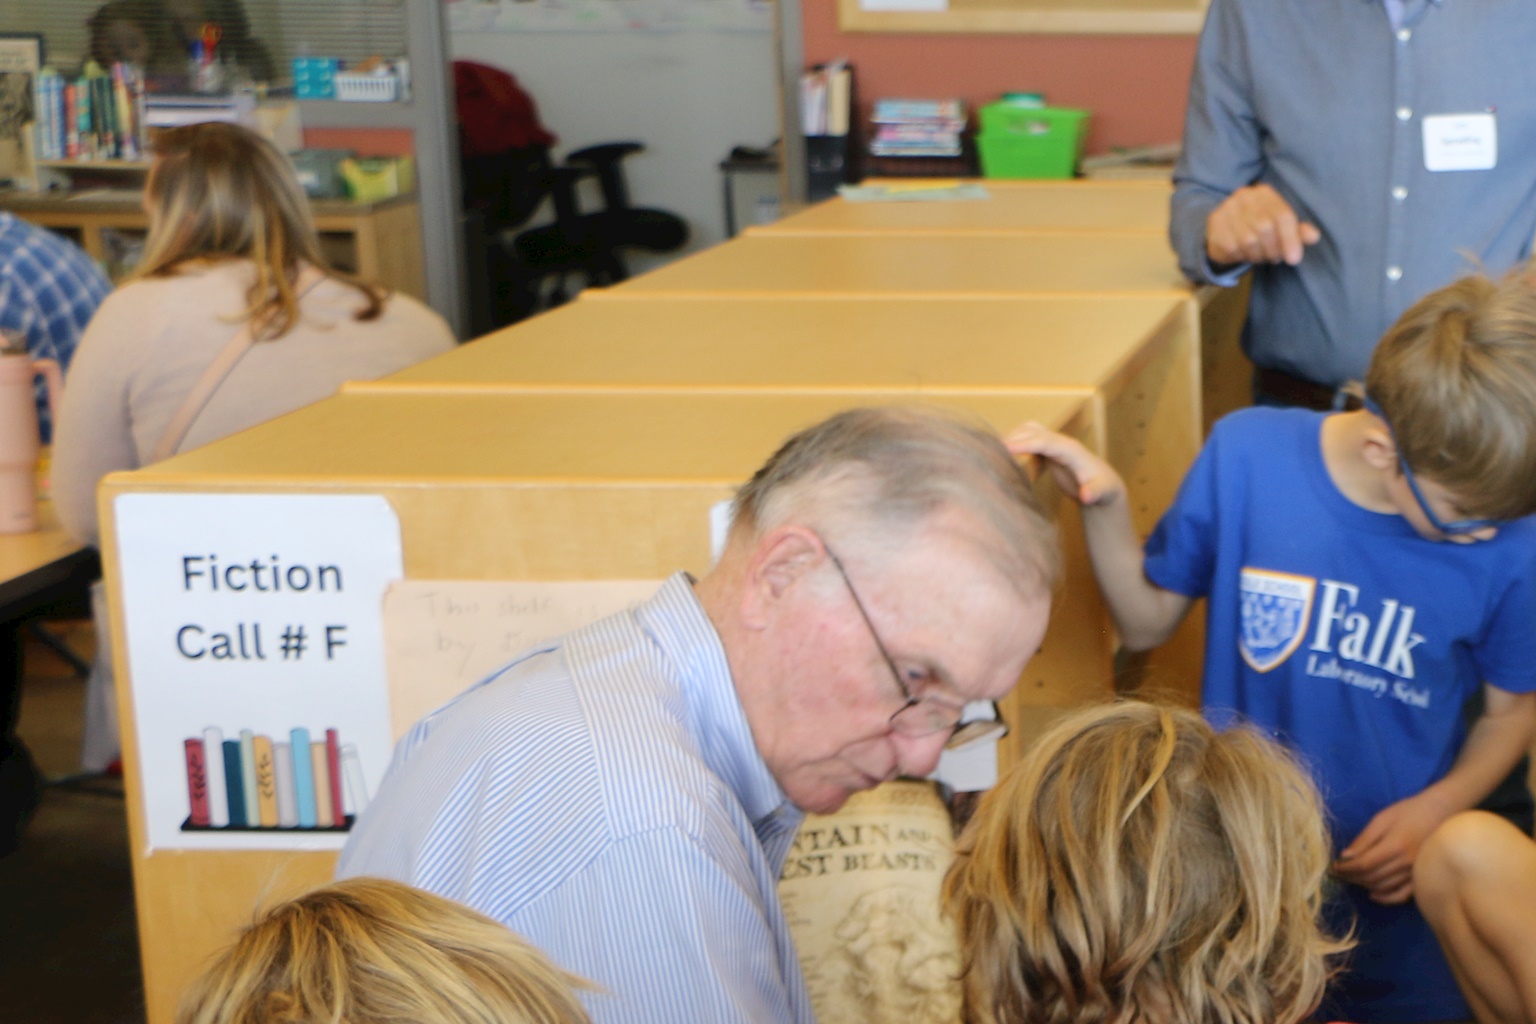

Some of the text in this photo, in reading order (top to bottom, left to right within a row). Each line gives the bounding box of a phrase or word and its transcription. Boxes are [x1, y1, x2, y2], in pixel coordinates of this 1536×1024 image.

[182, 554, 343, 591] Fiction
[176, 623, 347, 660] Call # F
[1309, 579, 1427, 680] Falk
[842, 850, 937, 873] BEASTS
